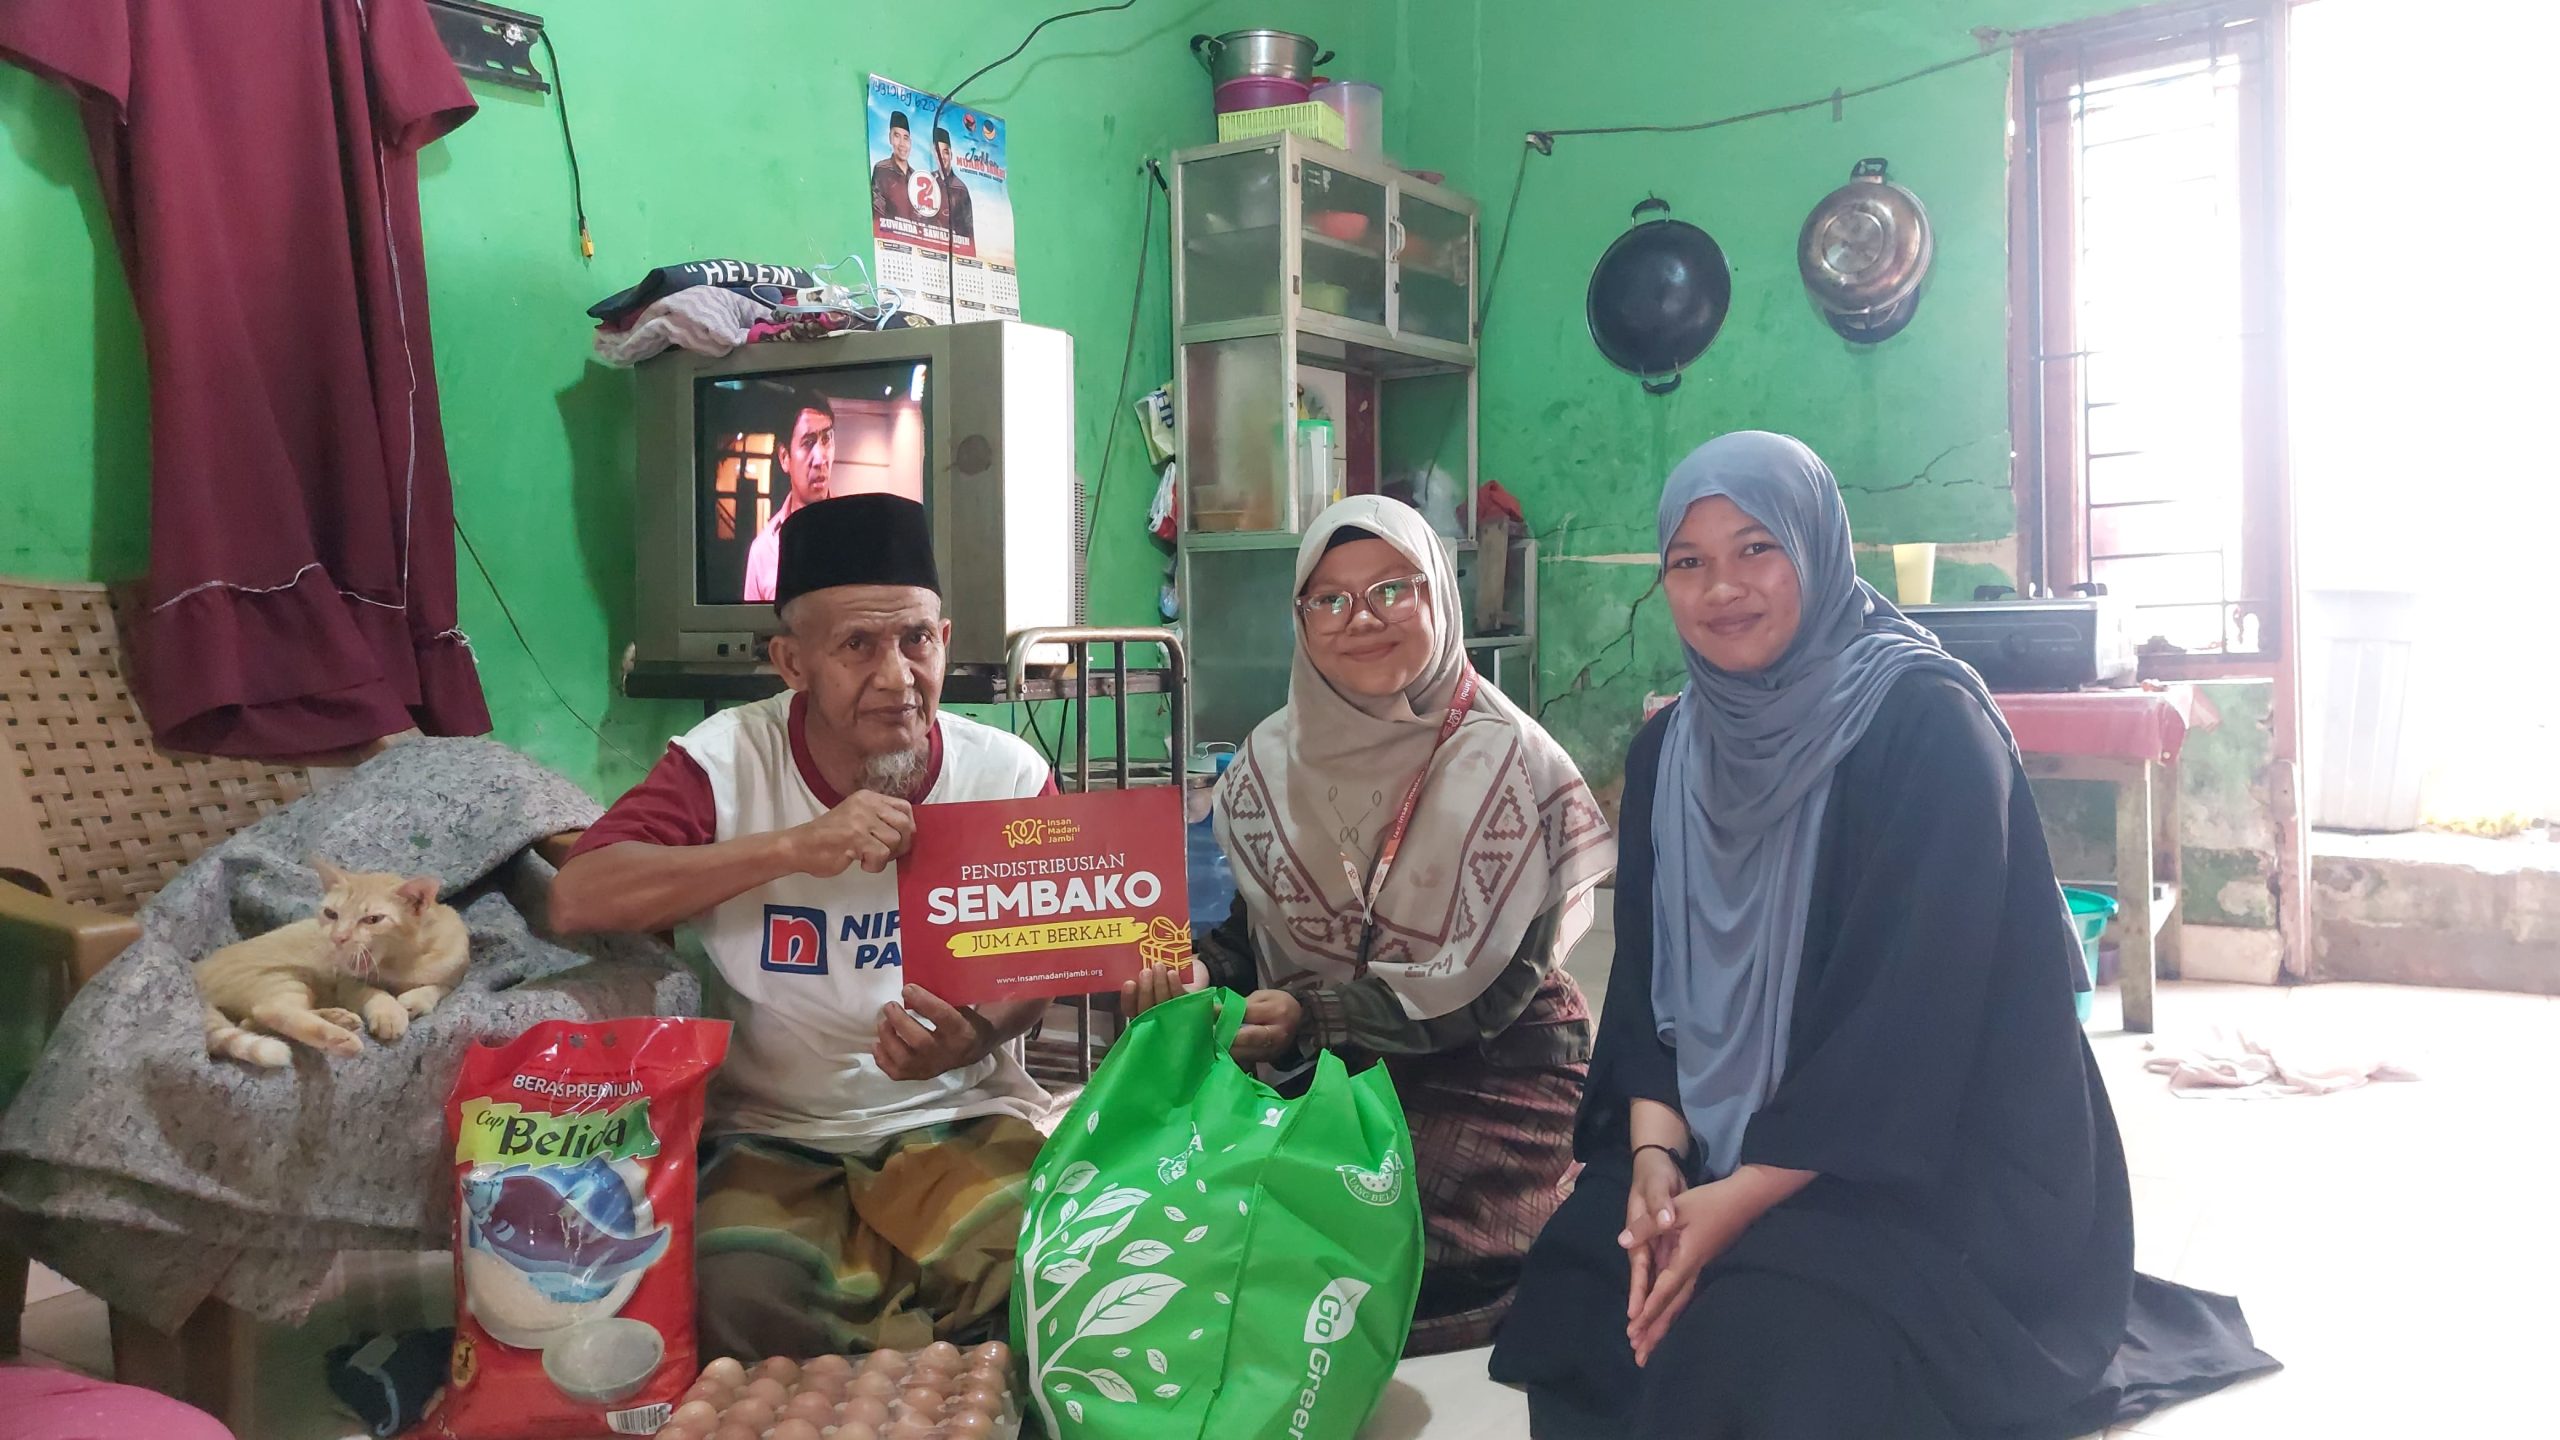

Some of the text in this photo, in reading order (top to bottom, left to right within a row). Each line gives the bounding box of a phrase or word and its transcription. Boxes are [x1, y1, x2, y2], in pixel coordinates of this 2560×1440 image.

[917, 176, 934, 208] 2
[1047, 819, 1072, 827] Insan
[1047, 825, 1080, 835] Madani
[1048, 834, 1075, 844] Jambi
[961, 853, 1125, 881] PENDISTRIBUSIAN
[927, 871, 1162, 925] SEMBAKO
[970, 923, 1122, 952] JUM'AT BERKAH
[996, 969, 1103, 984] www.insanmadanijambi.org
[512, 1074, 643, 1098] BERAS PREMIUM
[476, 1110, 628, 1158] Cap Belida
[1315, 1294, 1342, 1338] Go
